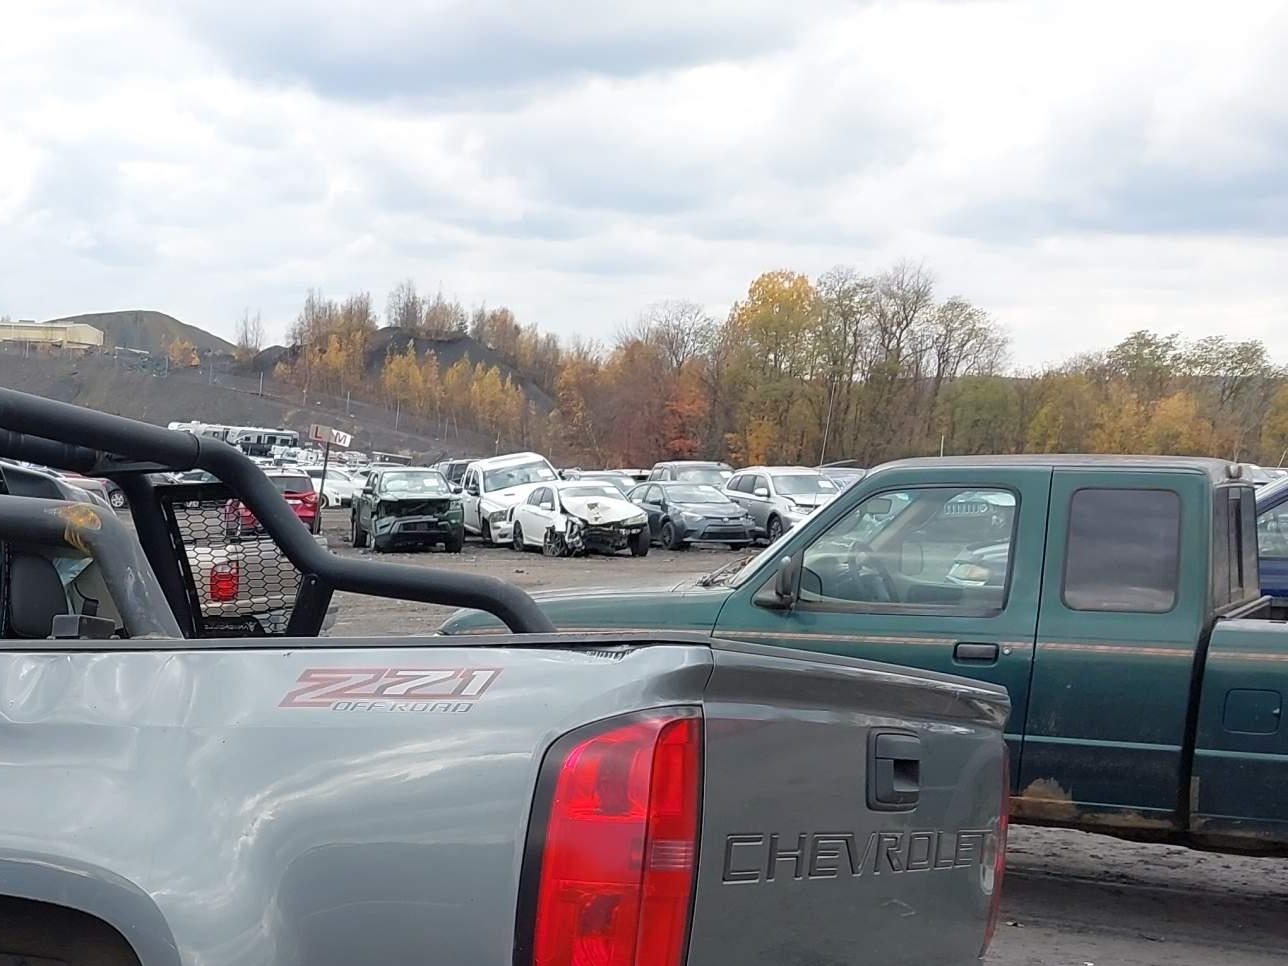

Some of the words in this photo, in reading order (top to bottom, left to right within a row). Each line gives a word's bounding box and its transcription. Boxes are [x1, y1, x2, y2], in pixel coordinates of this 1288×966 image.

[314, 426, 323, 439] L
[335, 431, 347, 445] M
[277, 667, 505, 708] Z71
[332, 702, 387, 713] OFF
[388, 702, 475, 713] ROAD
[721, 828, 994, 885] CHEVROLET
